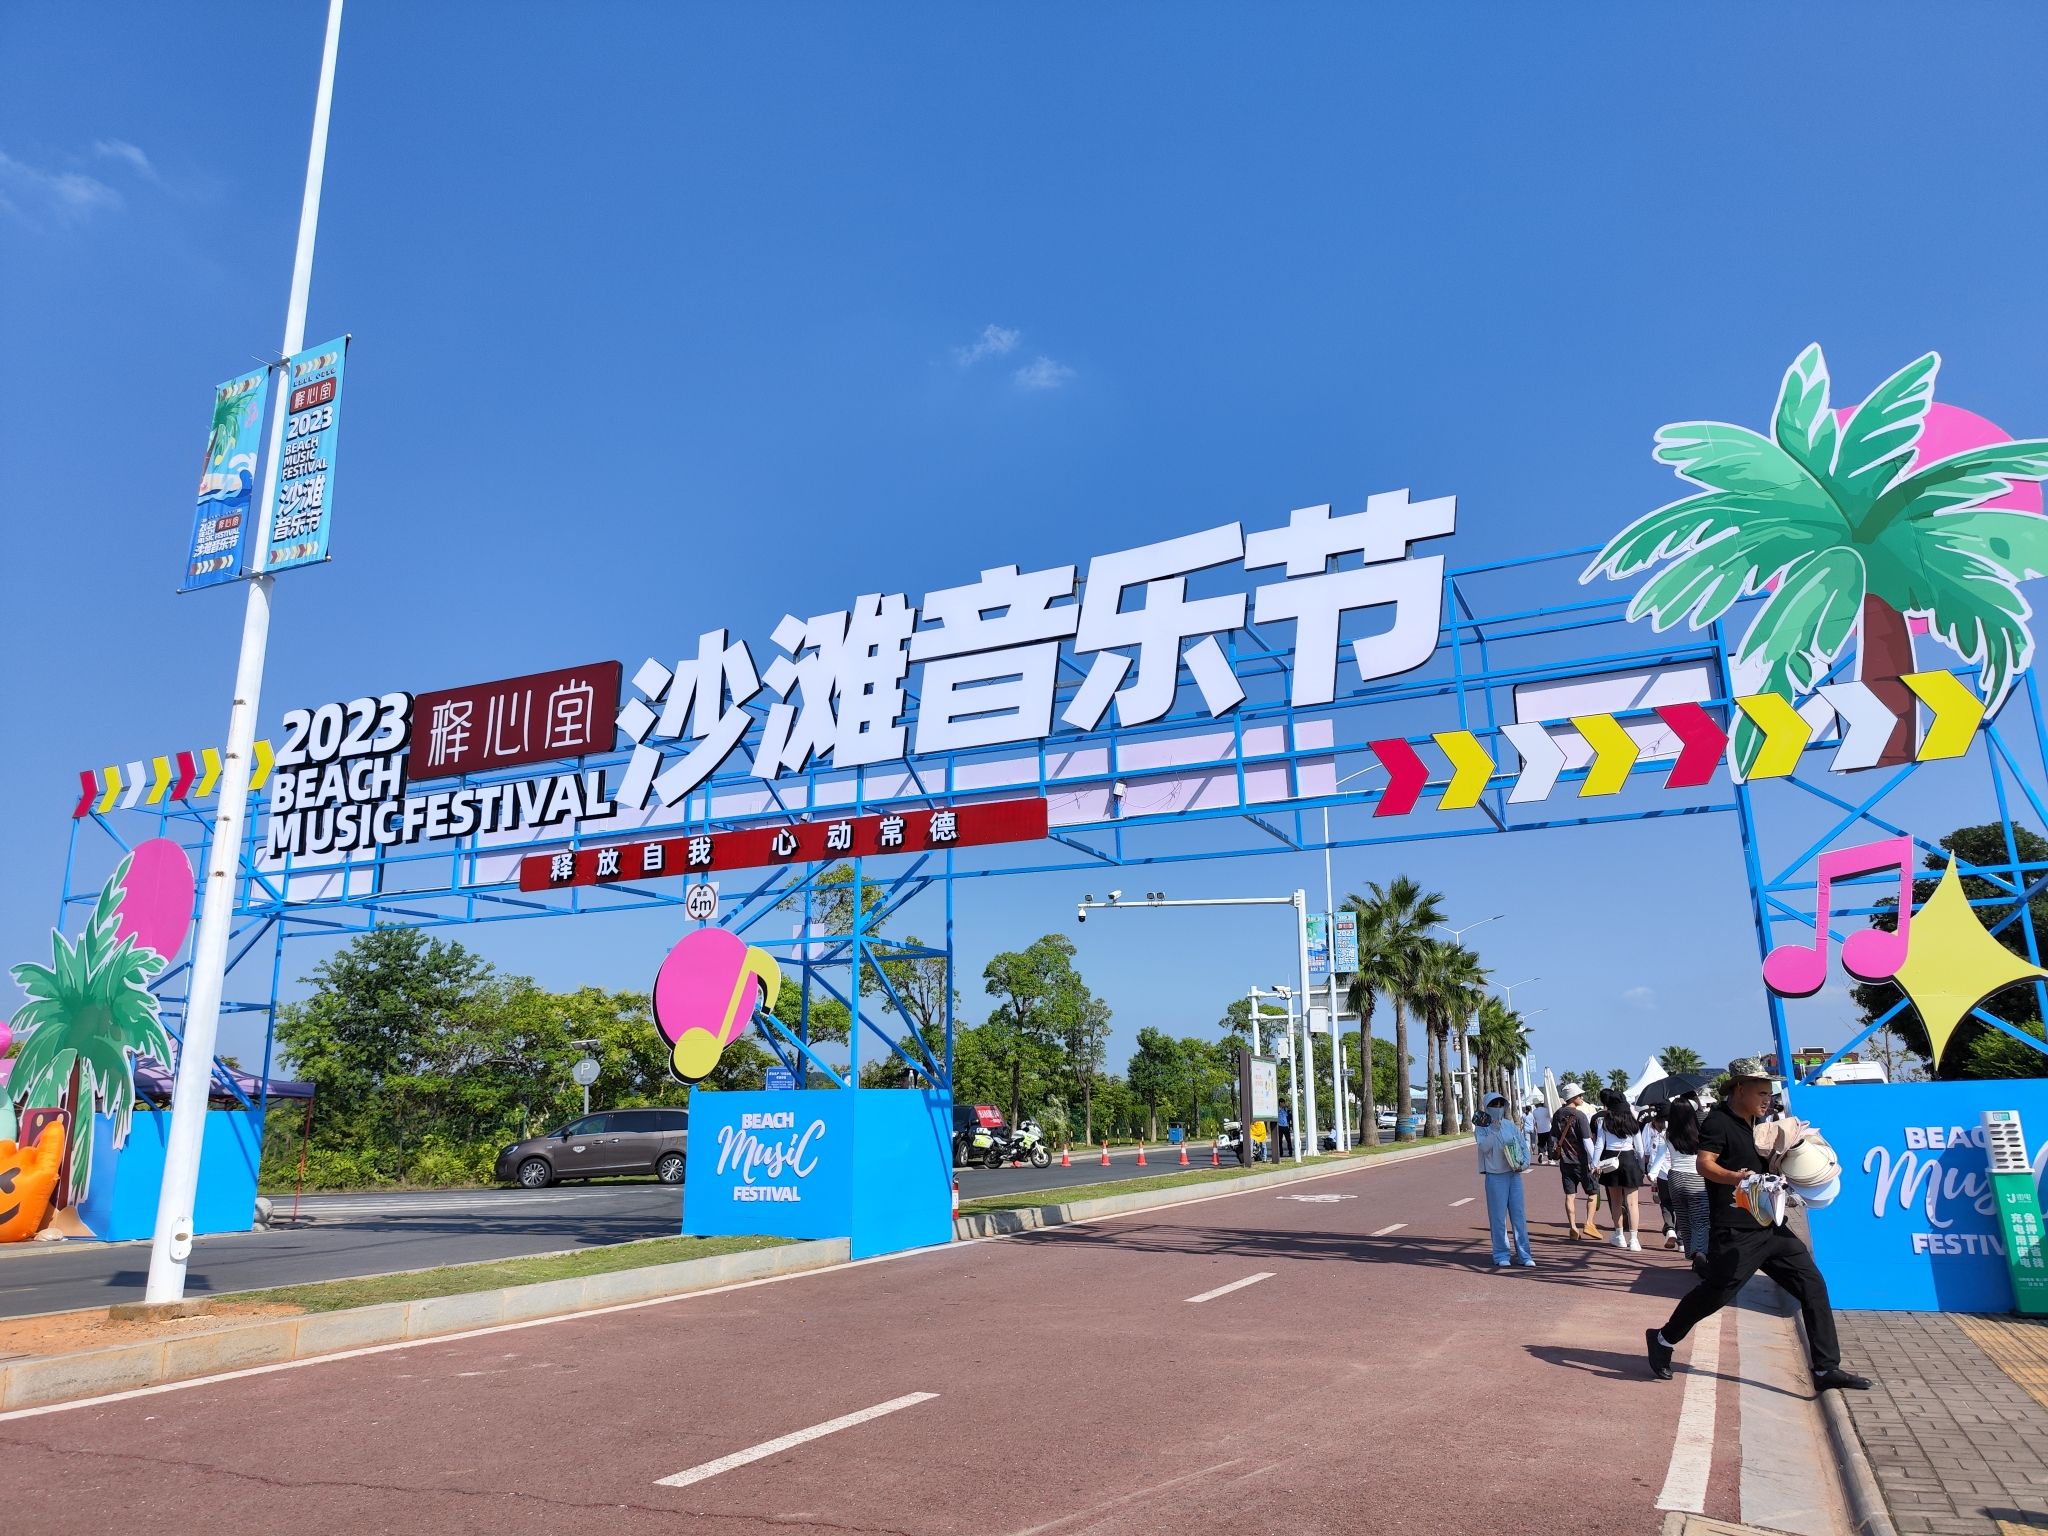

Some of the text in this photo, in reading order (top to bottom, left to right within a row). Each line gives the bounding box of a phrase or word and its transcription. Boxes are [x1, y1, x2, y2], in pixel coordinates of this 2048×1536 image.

[287, 406, 333, 441] 2023
[284, 449, 316, 469] MUSIC
[285, 436, 319, 457] BEACH
[282, 458, 328, 481] FESTIVAL
[276, 474, 325, 518] 沙滩
[273, 508, 323, 542] 音乐节
[612, 488, 1457, 809] 沙滩音乐节
[275, 692, 413, 767] 2023
[428, 678, 594, 768] 释心堂
[270, 755, 404, 813] BEACH
[551, 811, 958, 881] 释放自我 心动常德
[691, 898, 711, 911] 4m
[581, 1062, 590, 1075] P
[742, 1112, 794, 1130] BEACH
[1904, 1126, 1987, 1150] BEAC
[733, 1186, 801, 1202] FESTIVAL
